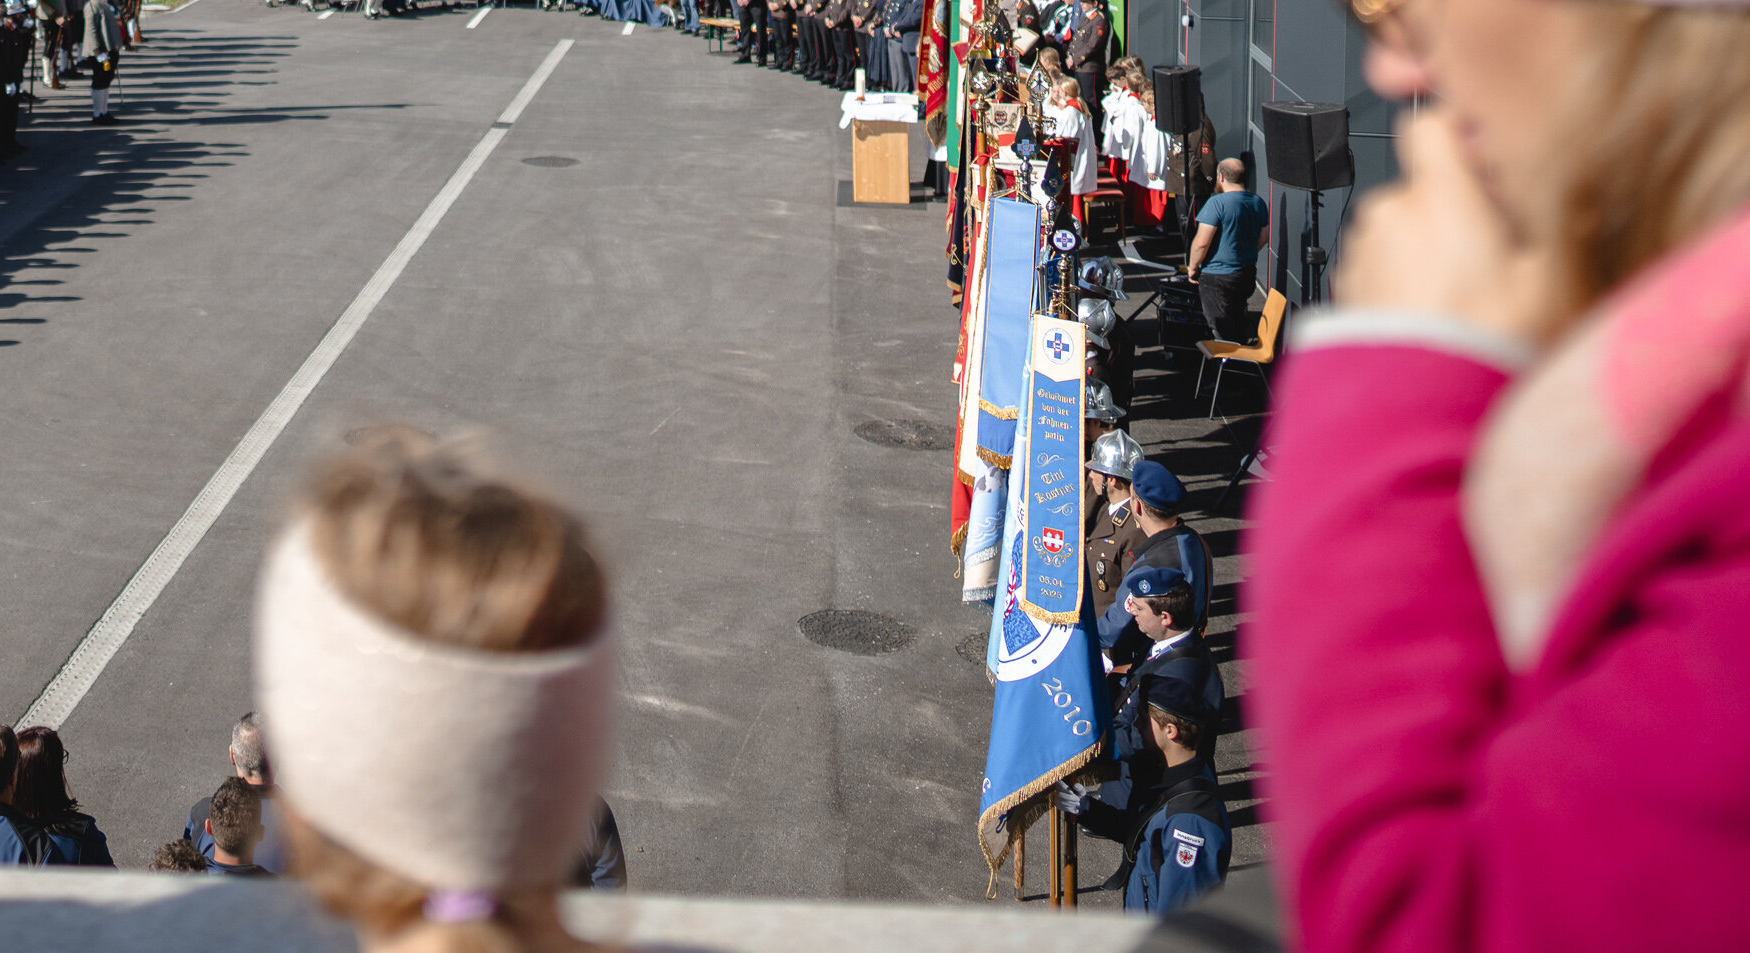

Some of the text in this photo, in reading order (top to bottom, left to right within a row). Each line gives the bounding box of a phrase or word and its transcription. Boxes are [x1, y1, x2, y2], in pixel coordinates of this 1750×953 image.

[1041, 403, 1069, 417] von der
[1040, 588, 1063, 599] 2025
[1041, 677, 1092, 736] 2010
